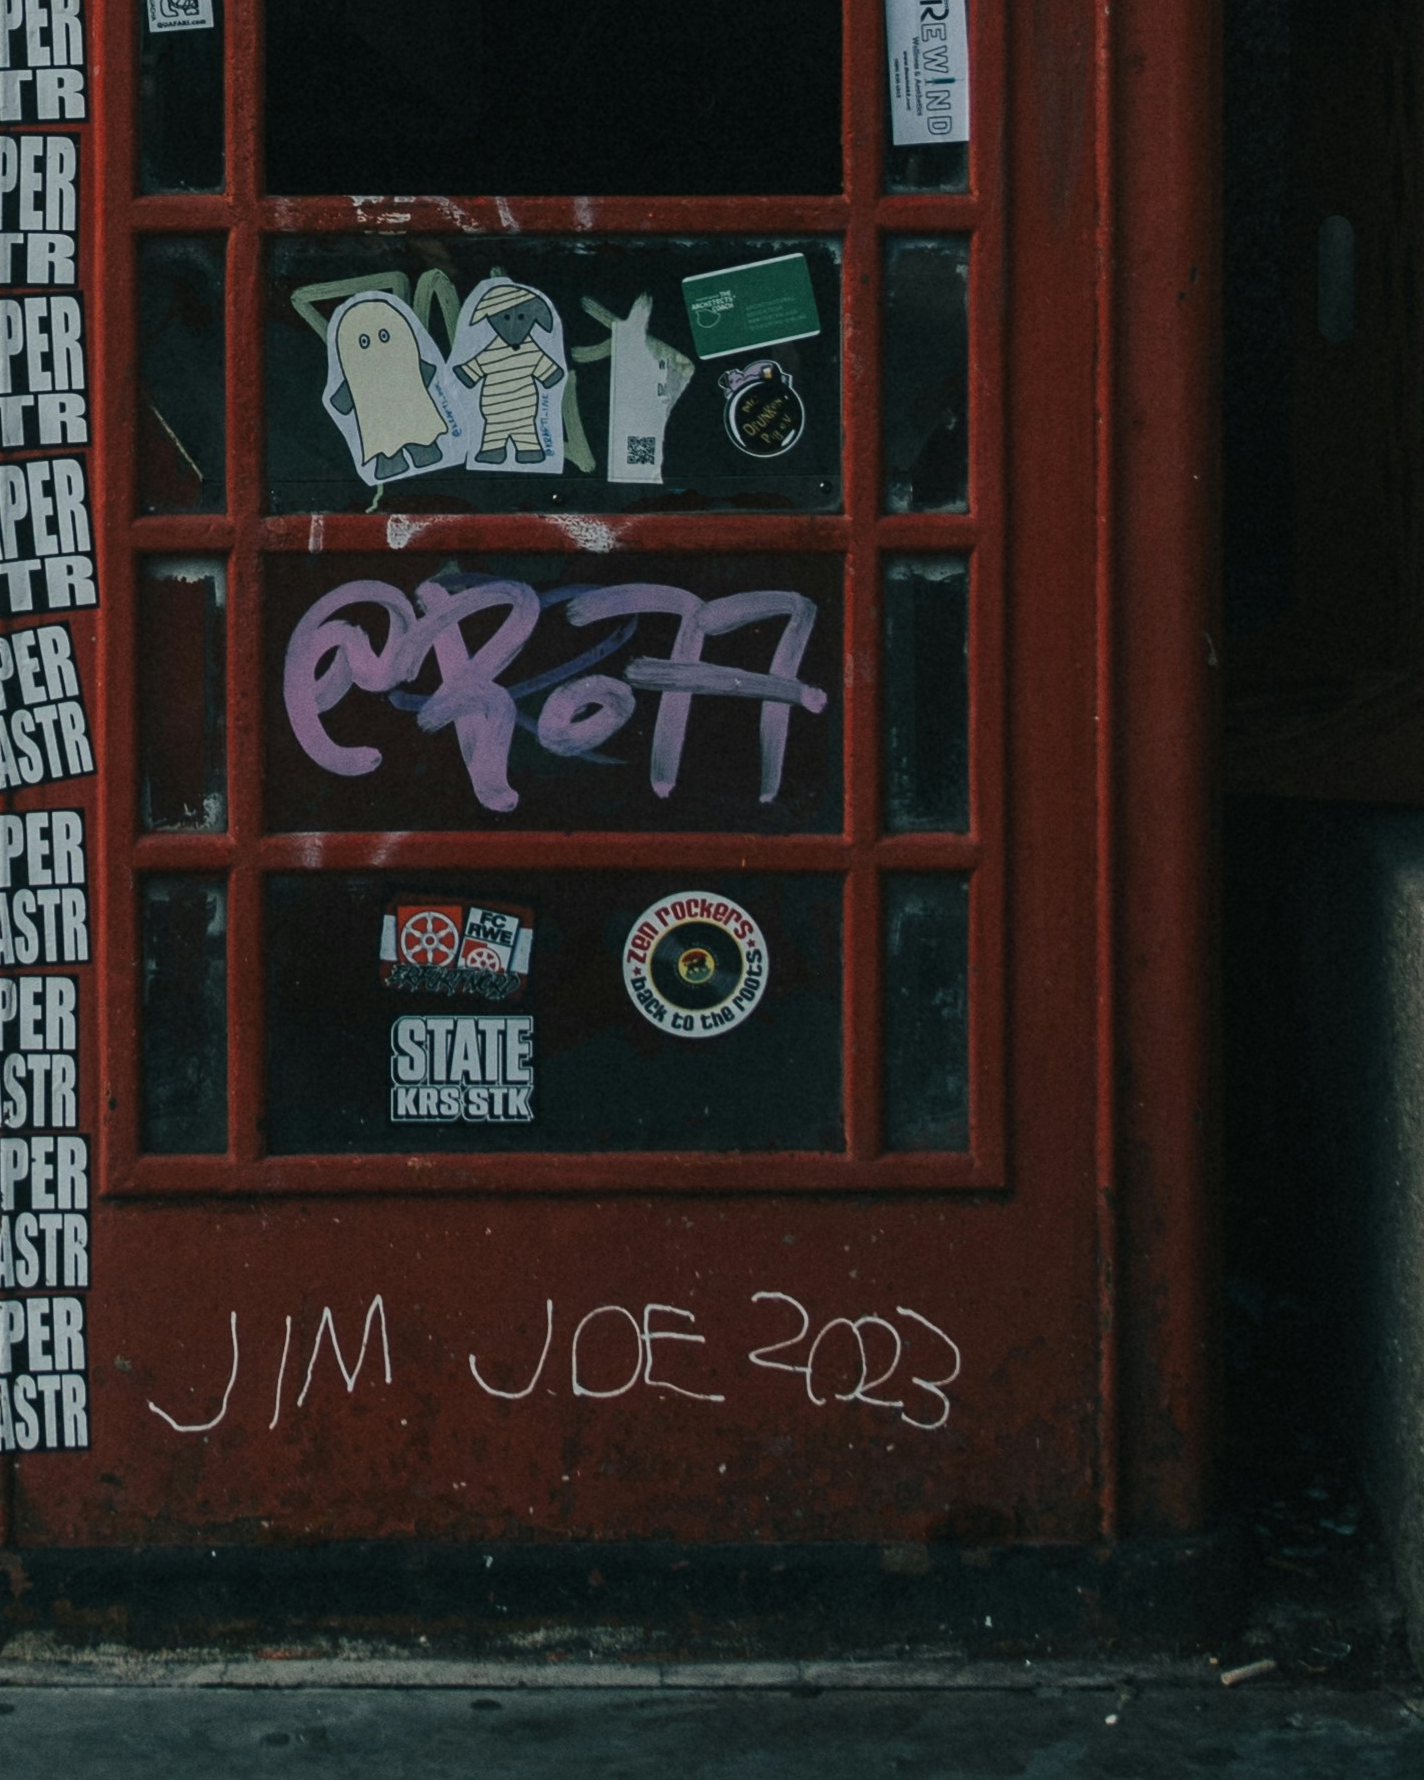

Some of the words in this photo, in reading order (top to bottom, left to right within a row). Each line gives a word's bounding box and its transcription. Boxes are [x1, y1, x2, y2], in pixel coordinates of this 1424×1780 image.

[468, 922, 513, 945] RWE
[479, 912, 507, 928] FC
[627, 921, 659, 964] zen
[655, 898, 753, 940] rockers
[631, 976, 667, 1023] back
[671, 1011, 694, 1031] to
[701, 1005, 736, 1030] the
[732, 948, 763, 1012] roots
[395, 1017, 531, 1084] STATE
[396, 1086, 460, 1118] KRS
[467, 1086, 530, 1118] STK
[148, 1293, 391, 1432] JIM
[470, 1299, 724, 1402] JOE
[749, 1291, 959, 1429] 2023
